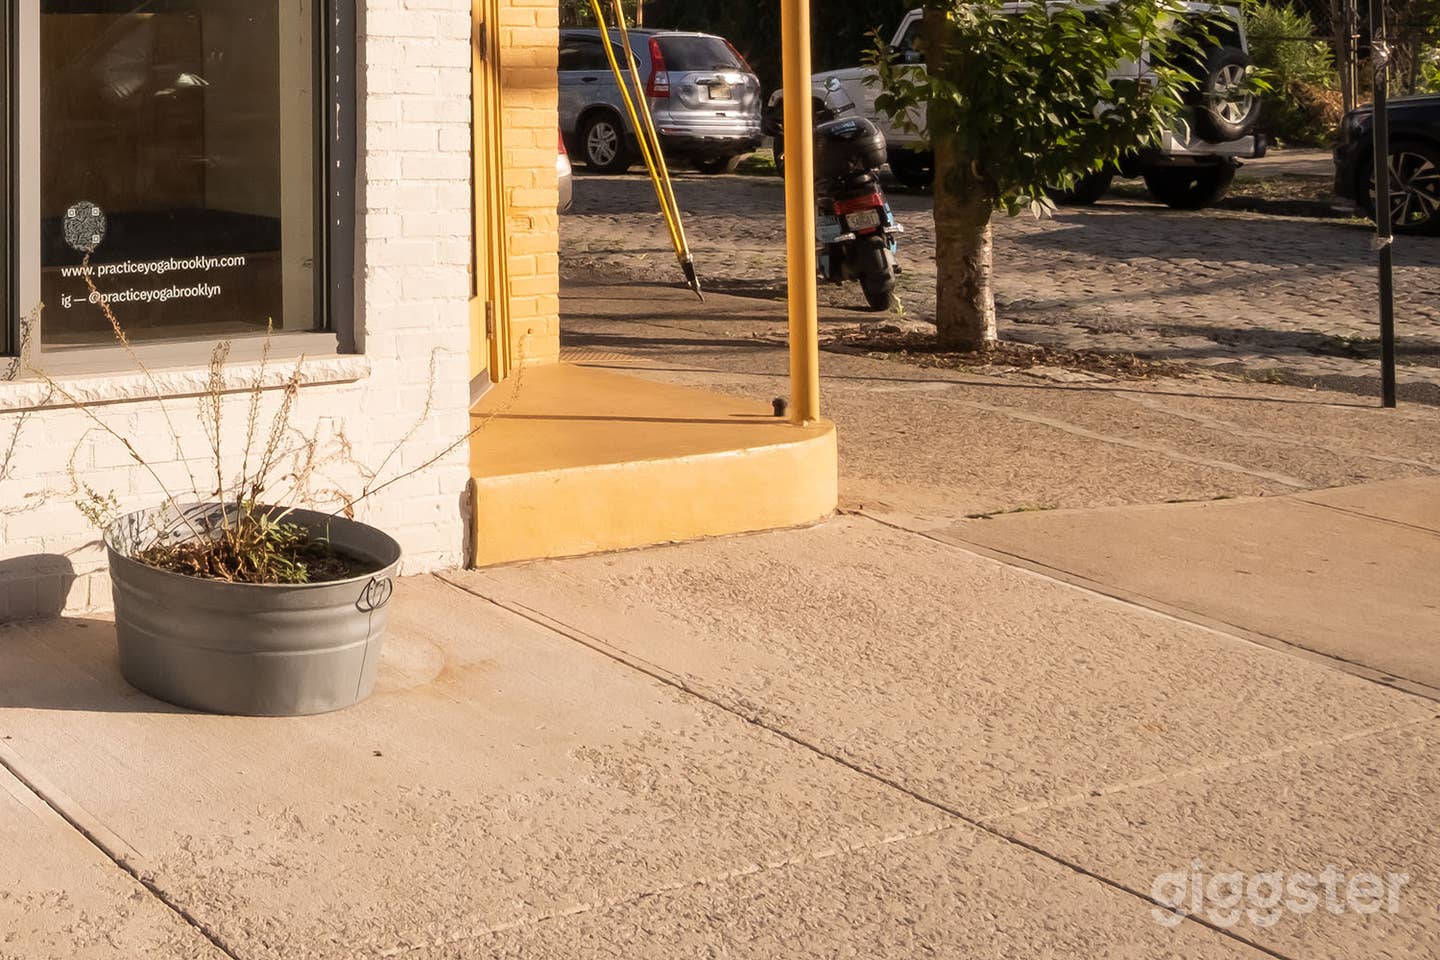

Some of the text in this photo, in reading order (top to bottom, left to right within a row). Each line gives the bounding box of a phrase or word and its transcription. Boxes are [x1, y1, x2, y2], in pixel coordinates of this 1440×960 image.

[61, 255, 246, 278] www. practiceyogabrooklyn.com
[61, 293, 72, 309] ig
[88, 283, 222, 305] @practiceyogabrooklyn
